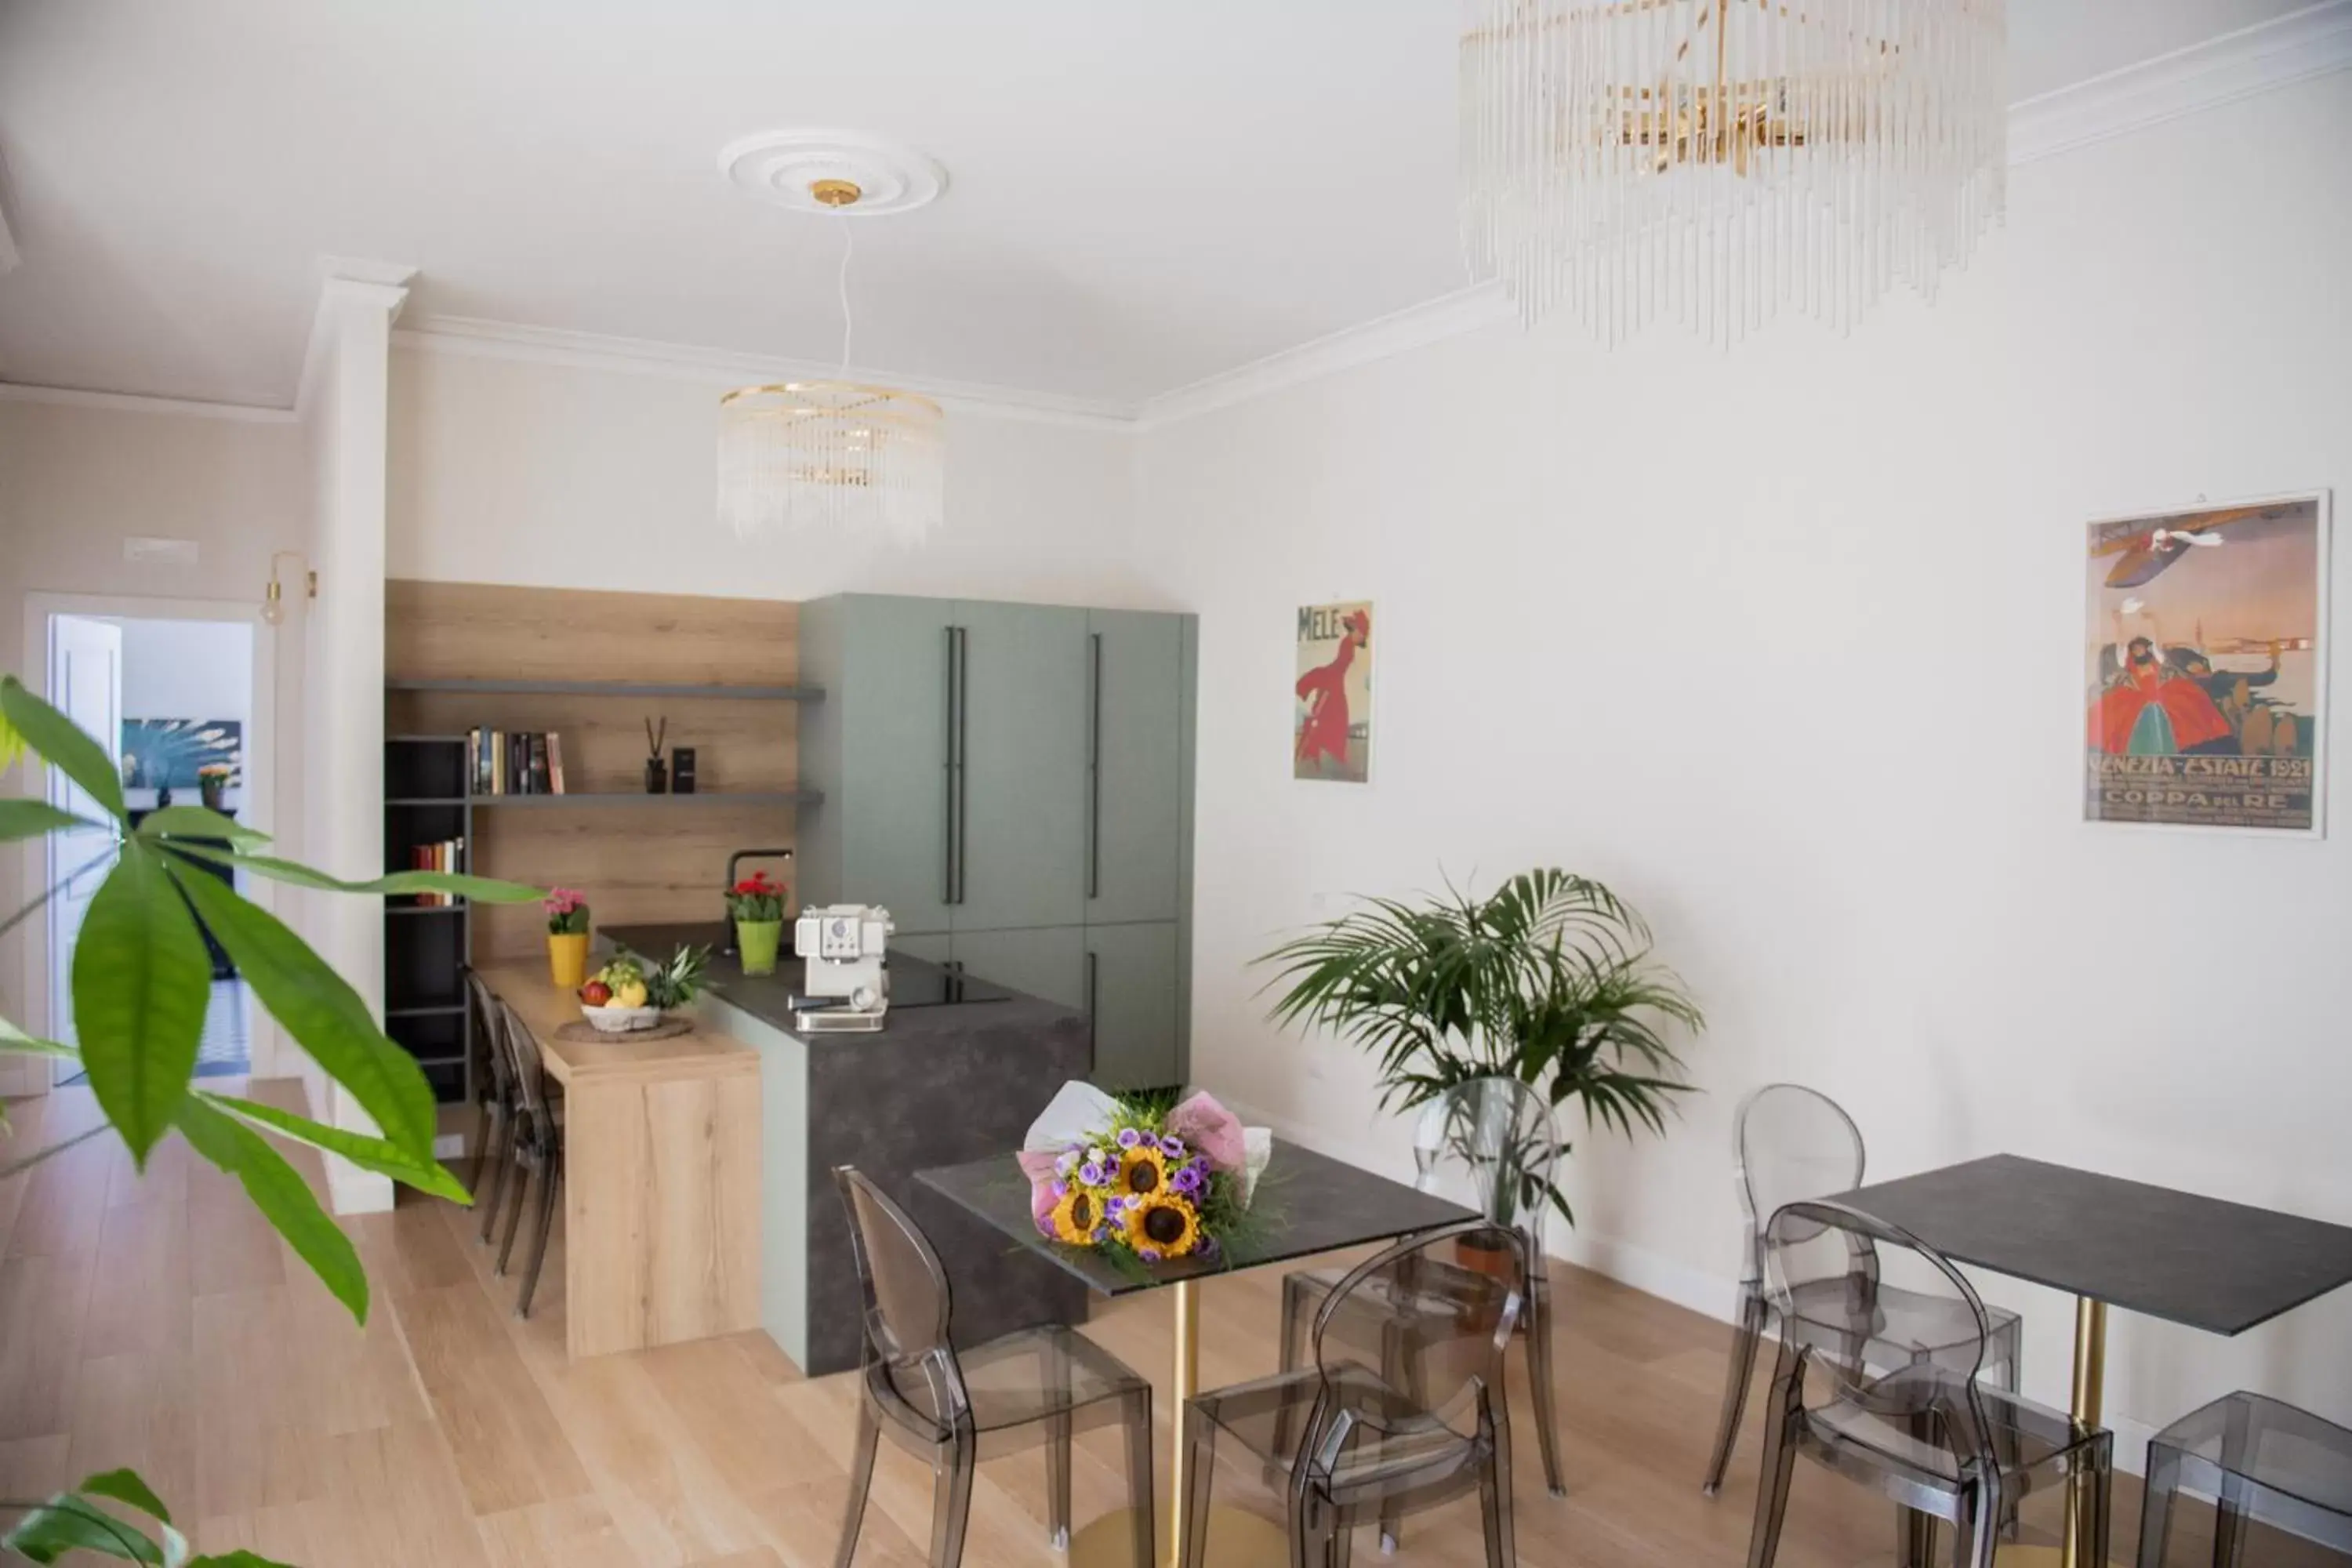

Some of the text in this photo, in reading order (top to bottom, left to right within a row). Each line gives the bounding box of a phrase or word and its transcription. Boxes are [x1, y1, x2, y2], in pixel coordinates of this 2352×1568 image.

[1298, 606, 1340, 641] MELE
[2270, 758, 2310, 778] 1921
[2105, 789, 2209, 806] COPPA
[2242, 793, 2288, 808] RE
